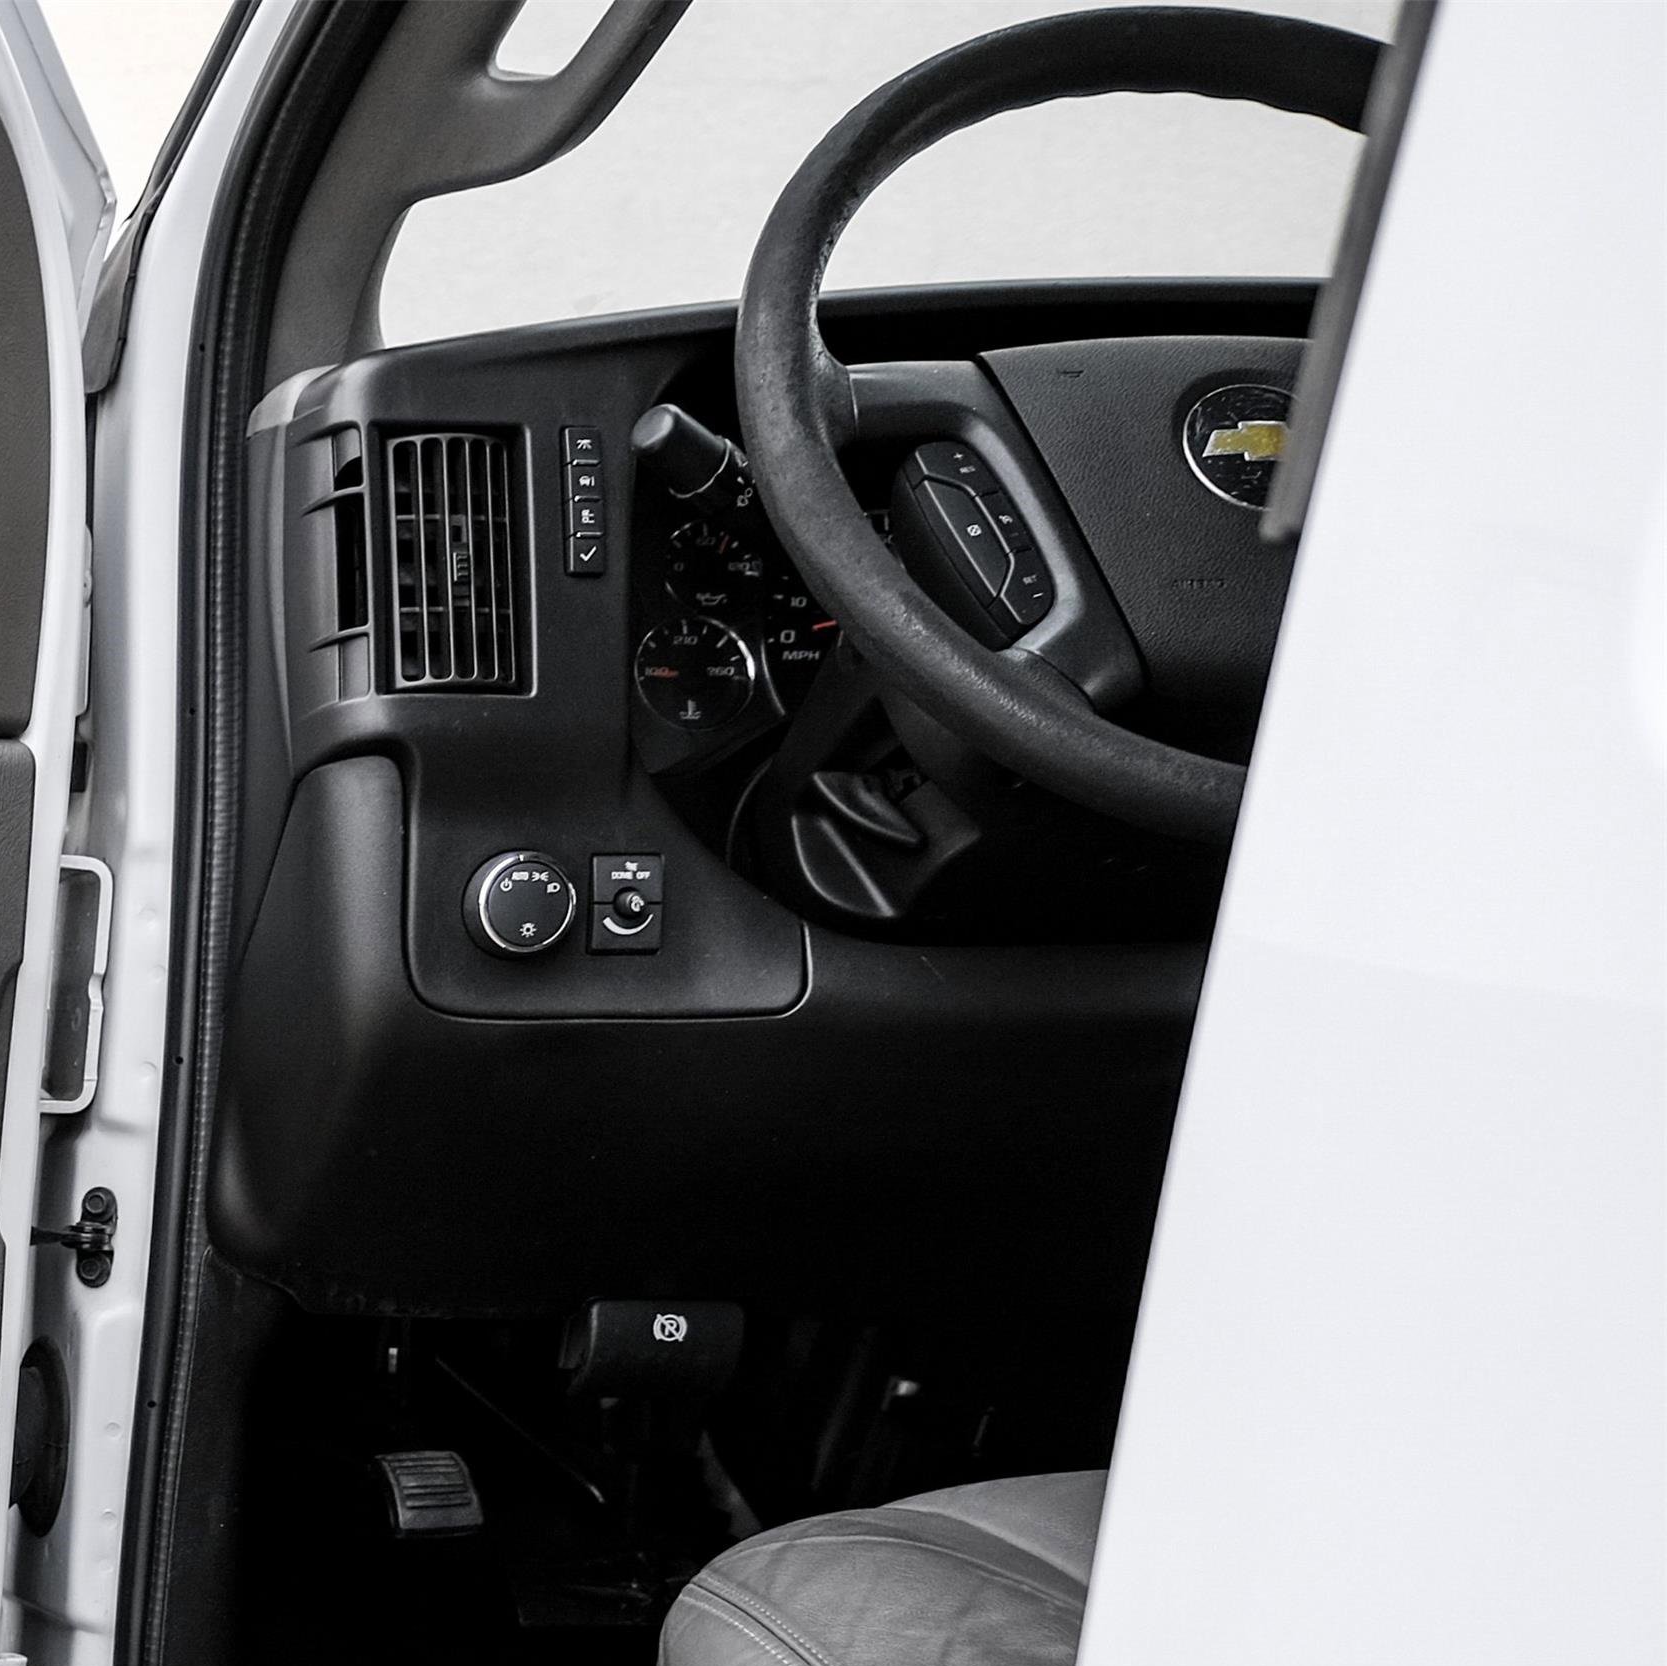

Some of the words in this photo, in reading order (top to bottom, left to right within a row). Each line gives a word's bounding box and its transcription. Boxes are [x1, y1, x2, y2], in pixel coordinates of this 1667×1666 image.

[790, 596, 808, 608] 10
[672, 635, 698, 645] 210
[780, 629, 796, 644] 0
[782, 650, 820, 661] MPH
